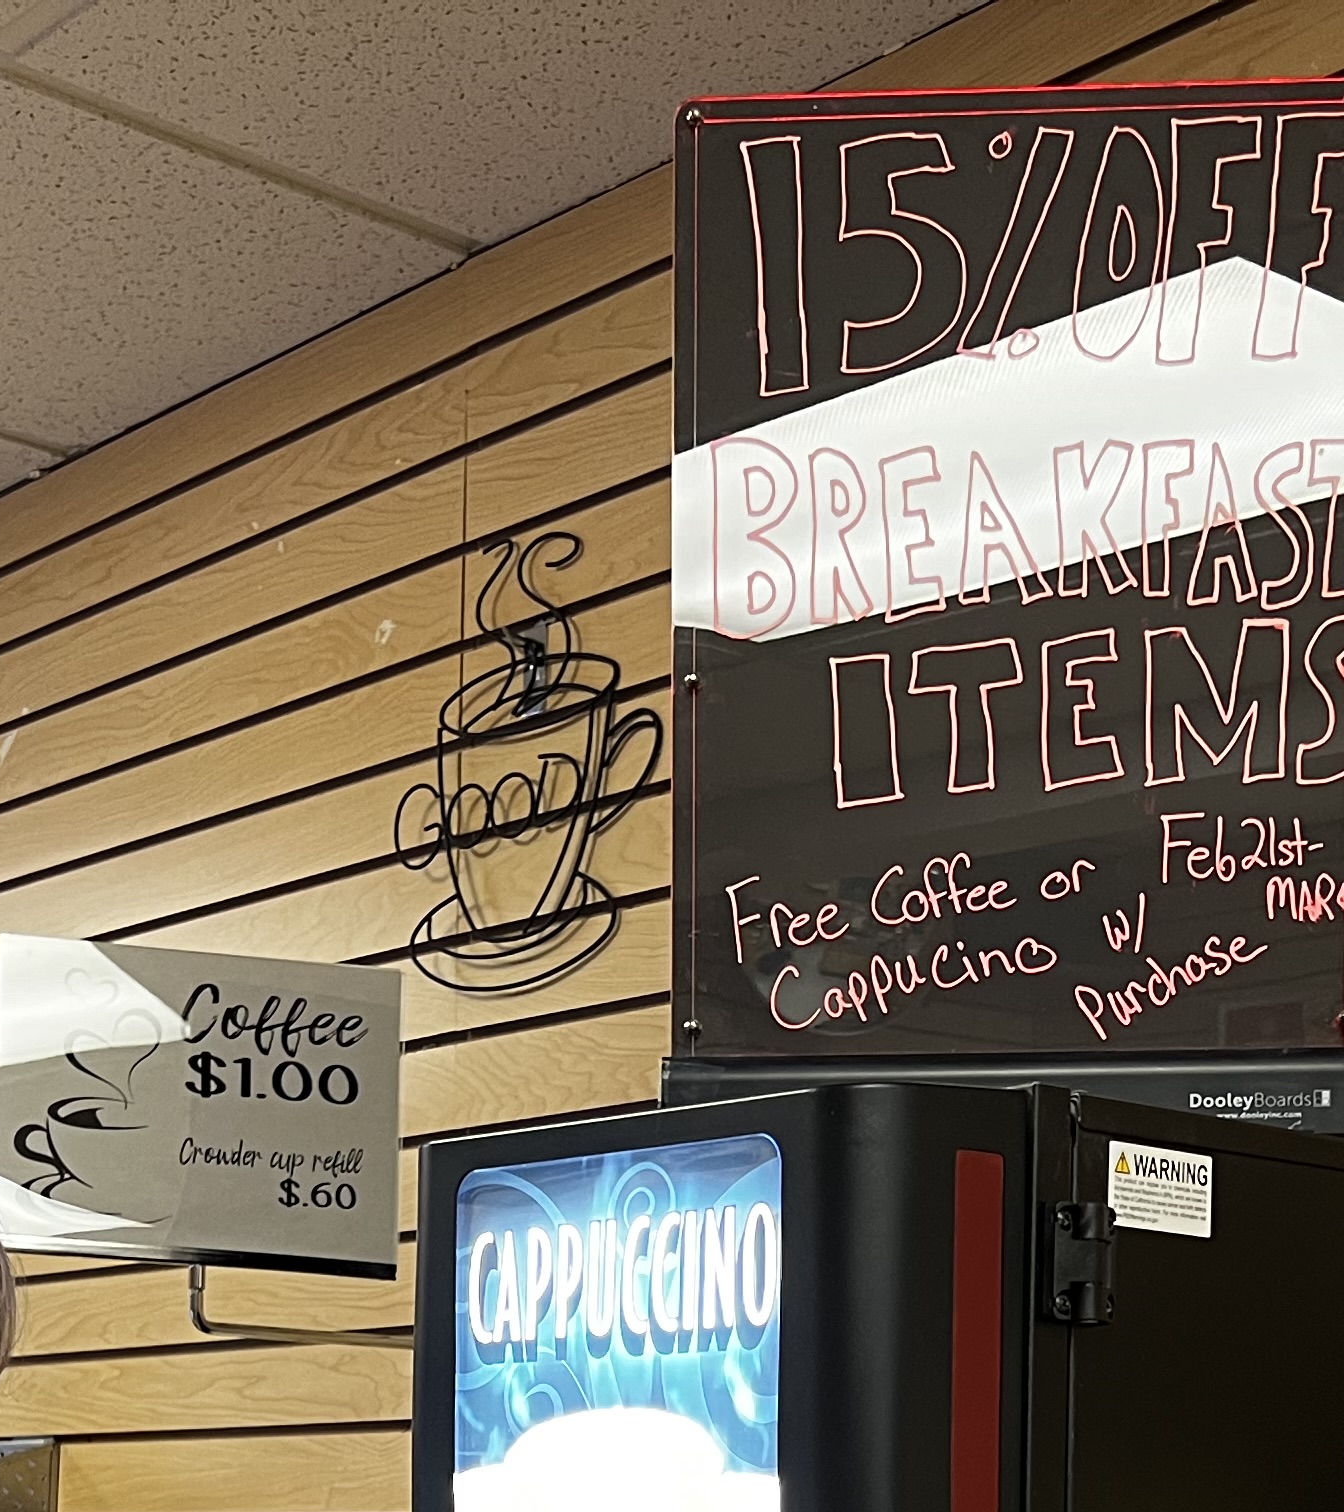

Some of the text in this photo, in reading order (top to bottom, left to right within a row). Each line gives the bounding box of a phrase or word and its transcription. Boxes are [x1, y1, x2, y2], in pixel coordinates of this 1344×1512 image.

[395, 754, 582, 870] GOOD
[1160, 813, 1236, 885] Feb
[726, 852, 1096, 963] Free Coffee or
[1266, 872, 1336, 923] MAR
[770, 893, 1147, 1030] Cappucino w/
[181, 983, 369, 1057] Coffee
[184, 1051, 360, 1105] $1.00
[1189, 1092, 1312, 1111] DooleyBoards
[179, 1137, 363, 1177] Crowder cup refill
[1133, 1153, 1208, 1187] WARNING
[278, 1178, 358, 1210] $.60
[468, 1202, 778, 1354] CAPPUCCINO
